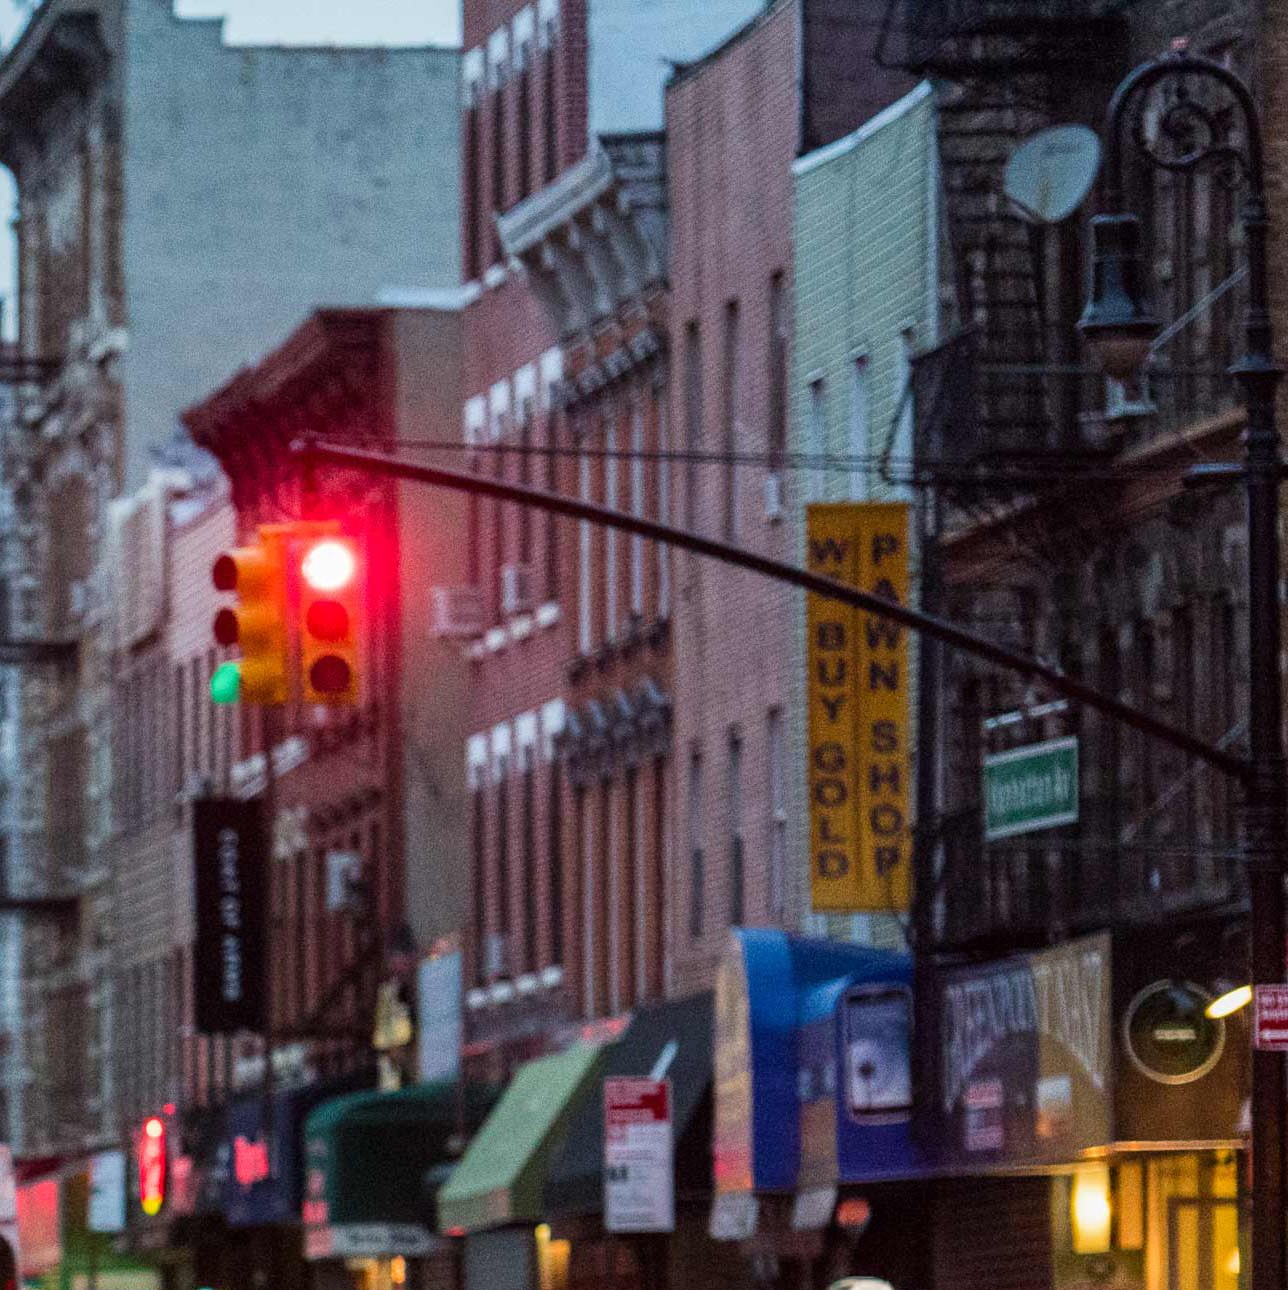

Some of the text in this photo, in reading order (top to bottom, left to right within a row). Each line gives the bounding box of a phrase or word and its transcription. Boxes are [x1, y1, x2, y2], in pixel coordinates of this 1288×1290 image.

[817, 621, 847, 723] BUY
[864, 533, 902, 877] PAWN SHOP
[814, 740, 849, 879] GOLD
